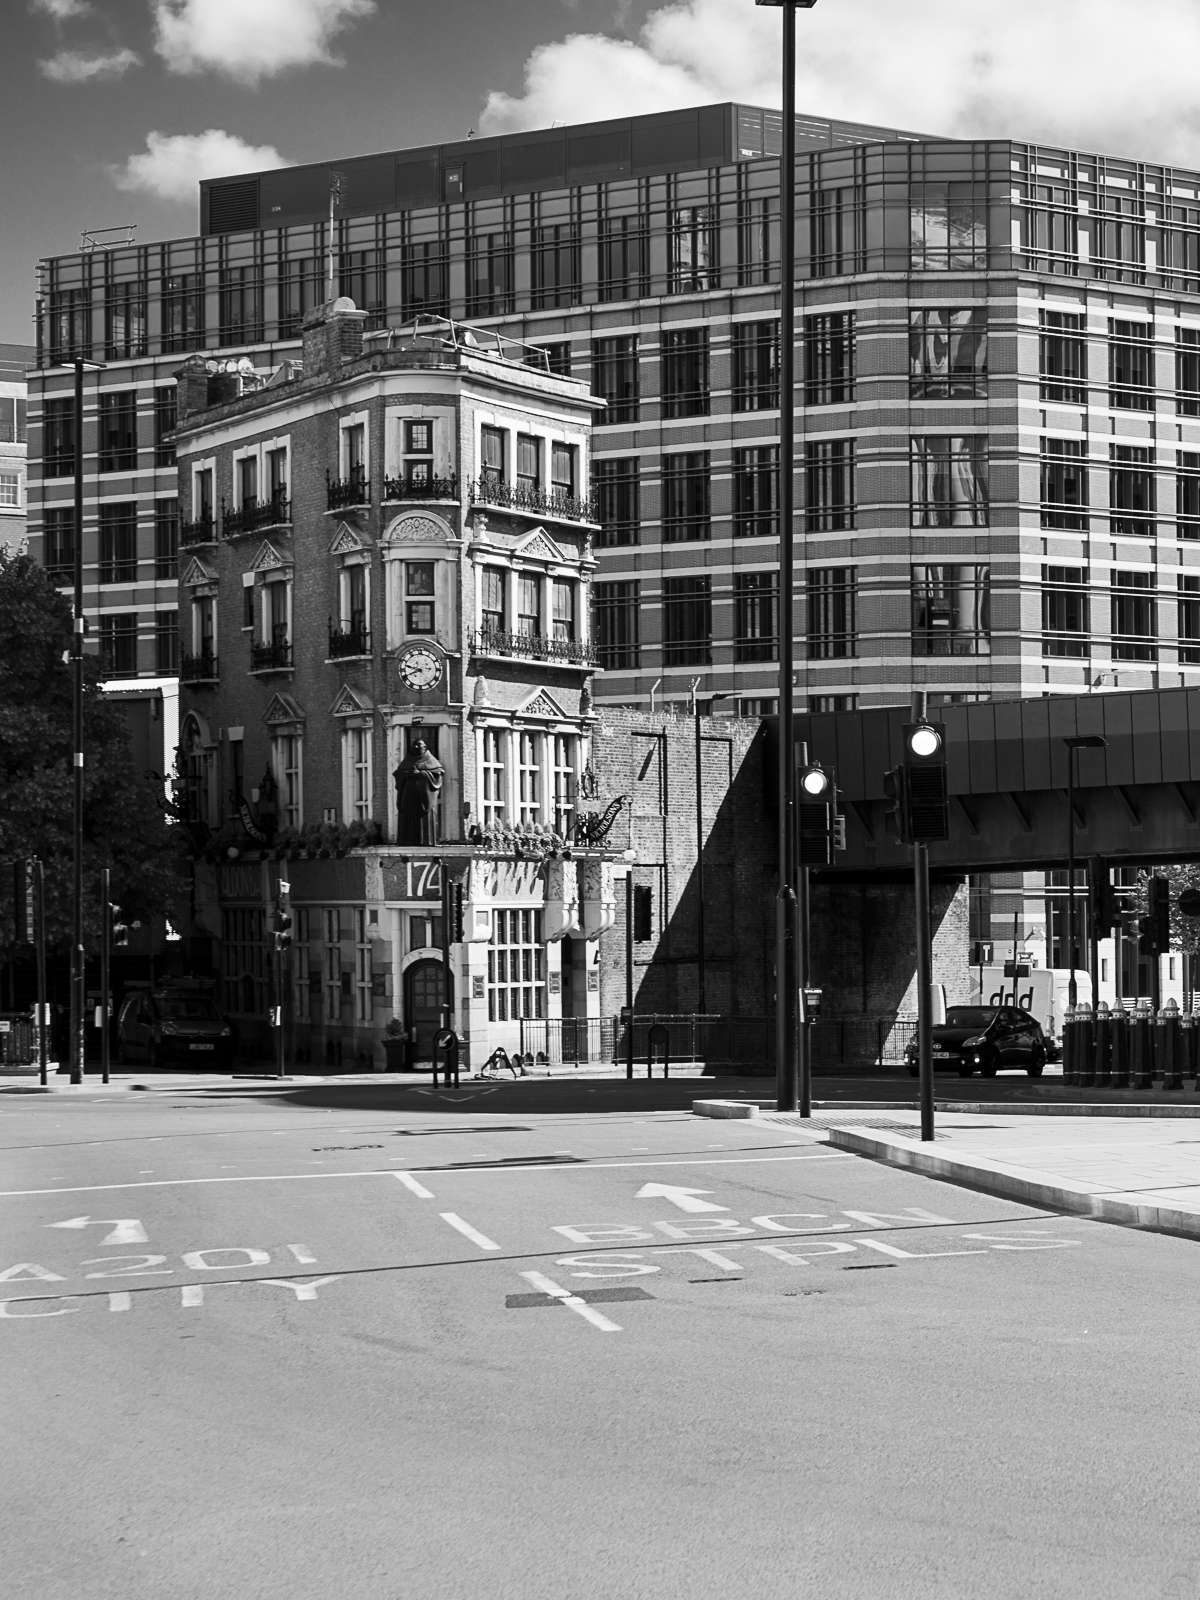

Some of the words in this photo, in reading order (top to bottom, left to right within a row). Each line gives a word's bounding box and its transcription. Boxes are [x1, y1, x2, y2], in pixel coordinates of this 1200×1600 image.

[406, 862, 442, 896] 174
[551, 1207, 955, 1242] BBCN
[0, 1244, 317, 1282] A201
[555, 1230, 1082, 1278] STPLS
[0, 1275, 345, 1318] CITY
